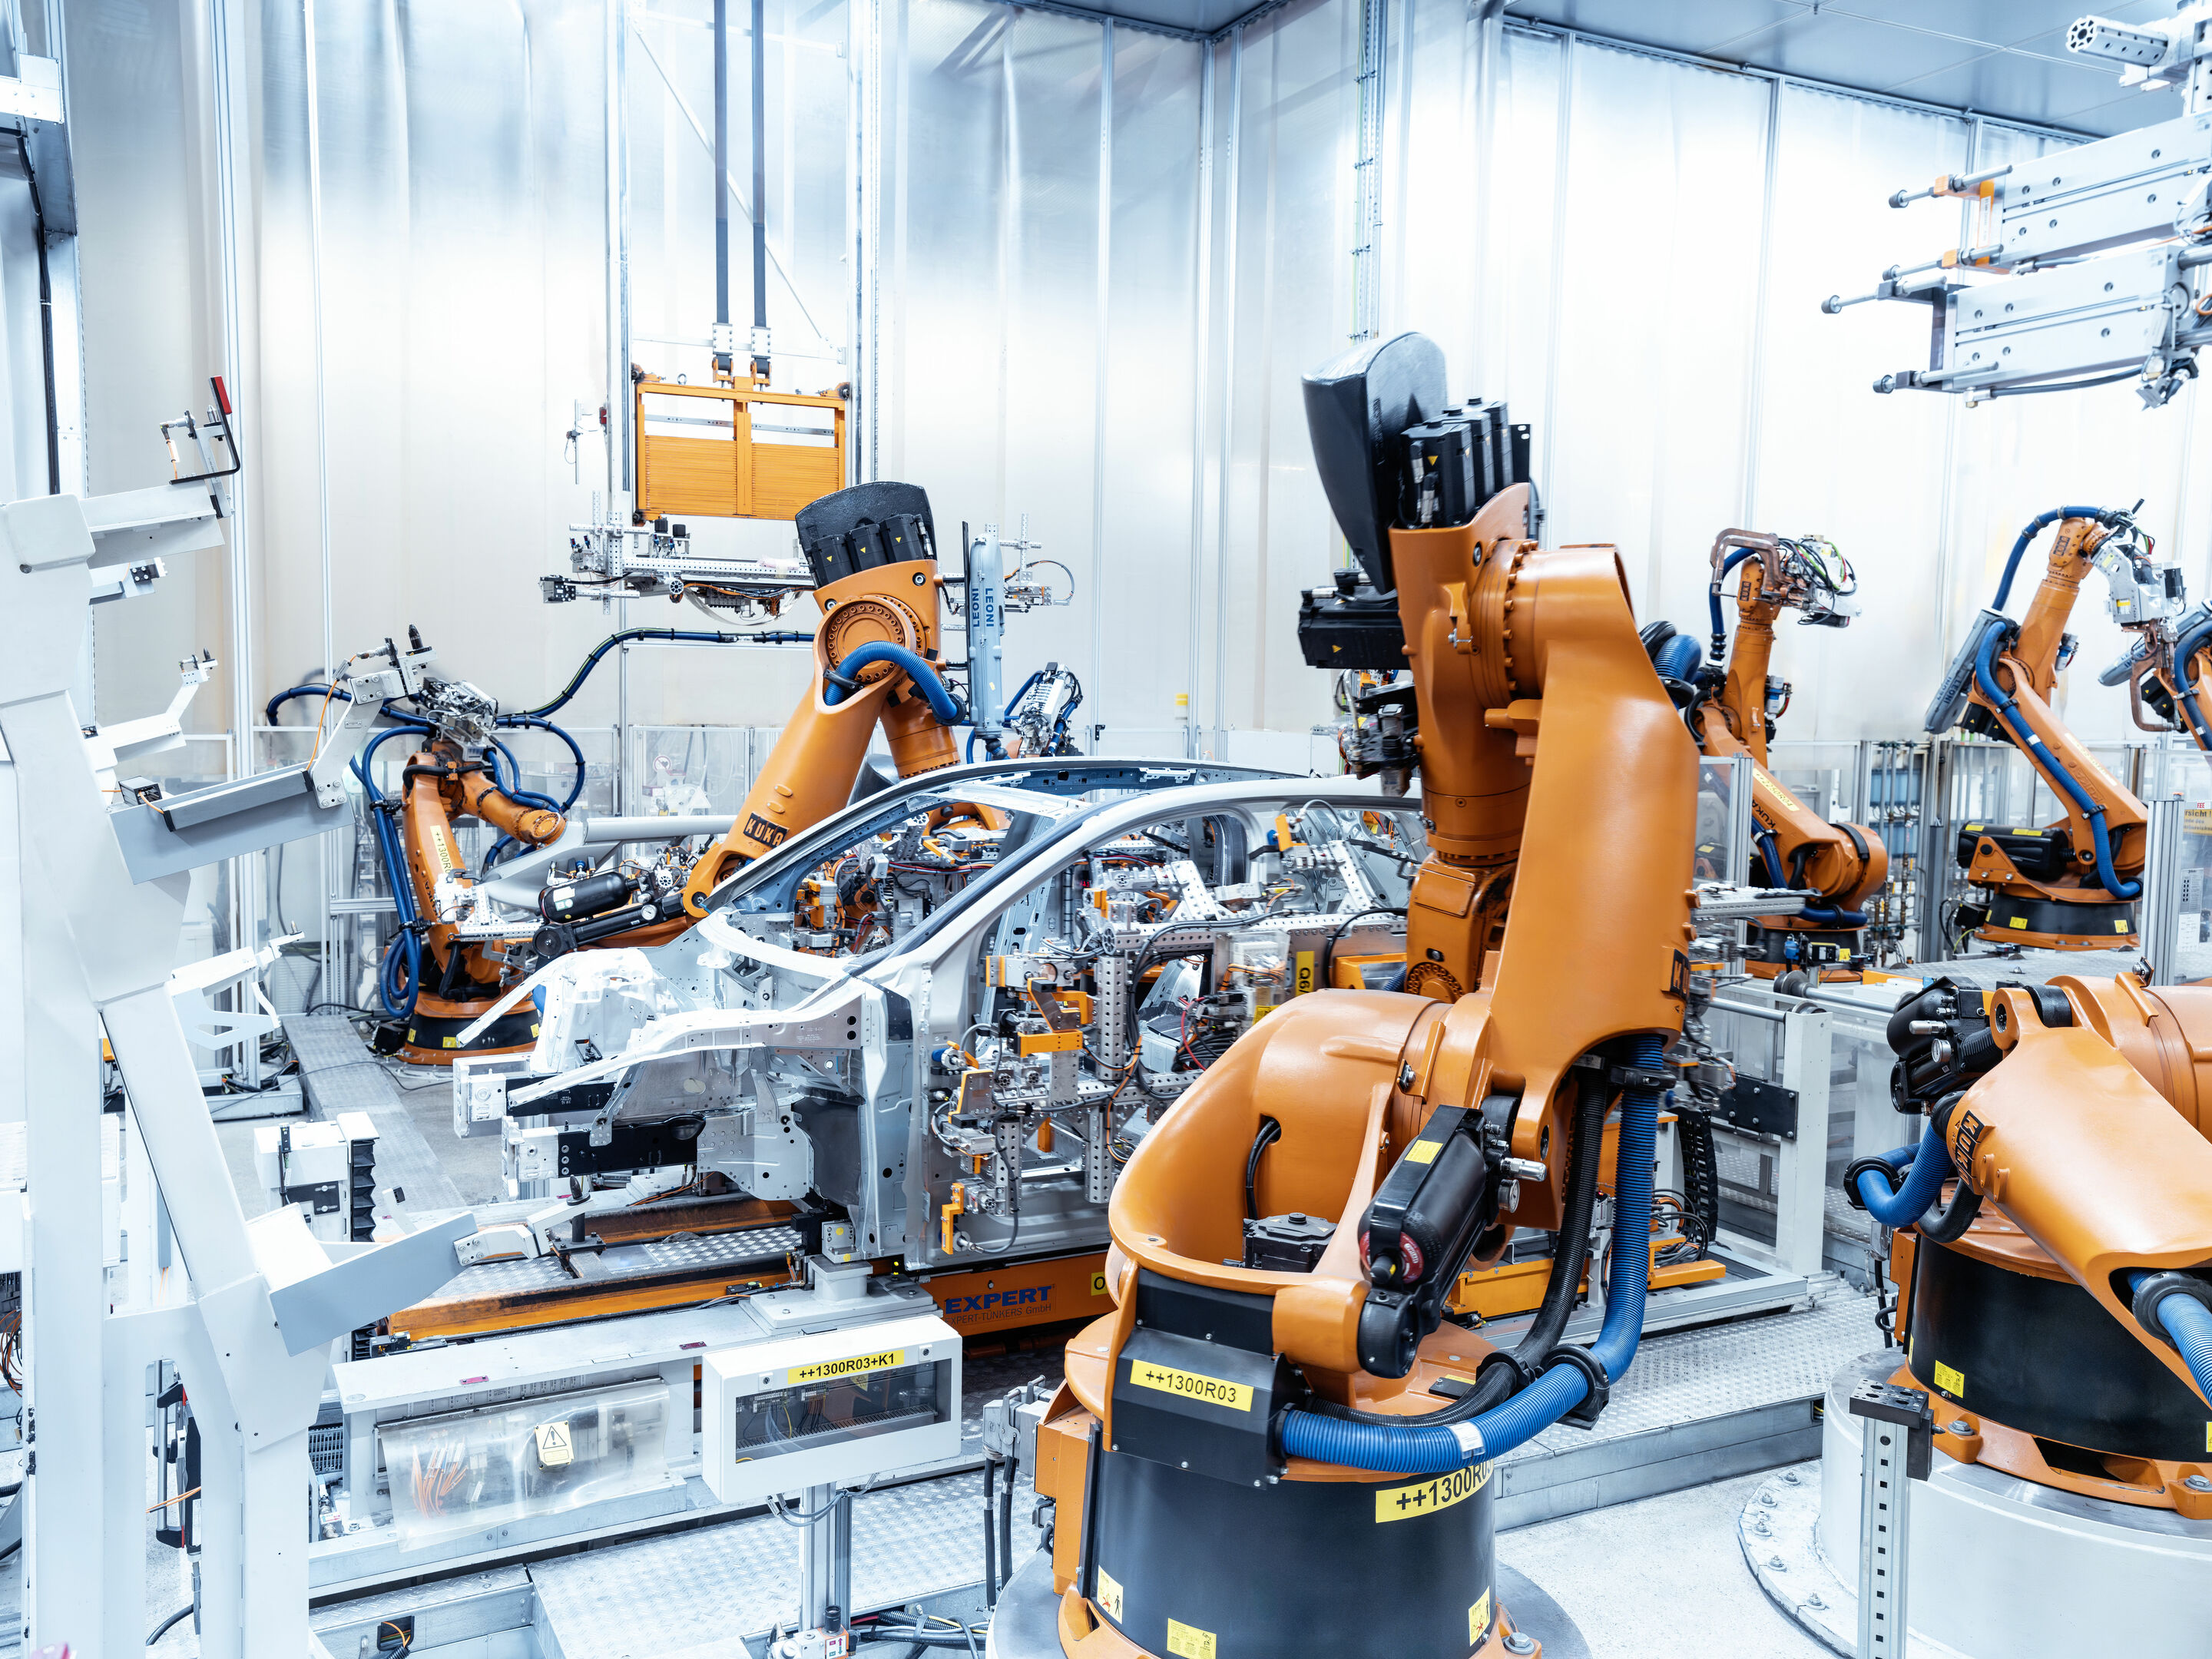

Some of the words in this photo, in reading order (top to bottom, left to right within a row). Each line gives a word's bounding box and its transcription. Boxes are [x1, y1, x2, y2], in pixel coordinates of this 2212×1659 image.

[1741, 581, 1750, 601] KUKA
[972, 588, 980, 628] LEONI
[985, 588, 995, 628] LEONI
[1943, 680, 1962, 704] LEONI
[1752, 799, 1776, 828] KUKA
[2184, 810, 2207, 818] rsicht
[745, 818, 784, 846] KUKA
[435, 831, 452, 874] ++1300R0
[1673, 960, 1690, 994] KU
[945, 1285, 1052, 1315] EXPERT
[1025, 1303, 1052, 1315] GmbH
[799, 1353, 895, 1379] ++1300R03+K1
[1145, 1370, 1237, 1402] ++1300R03
